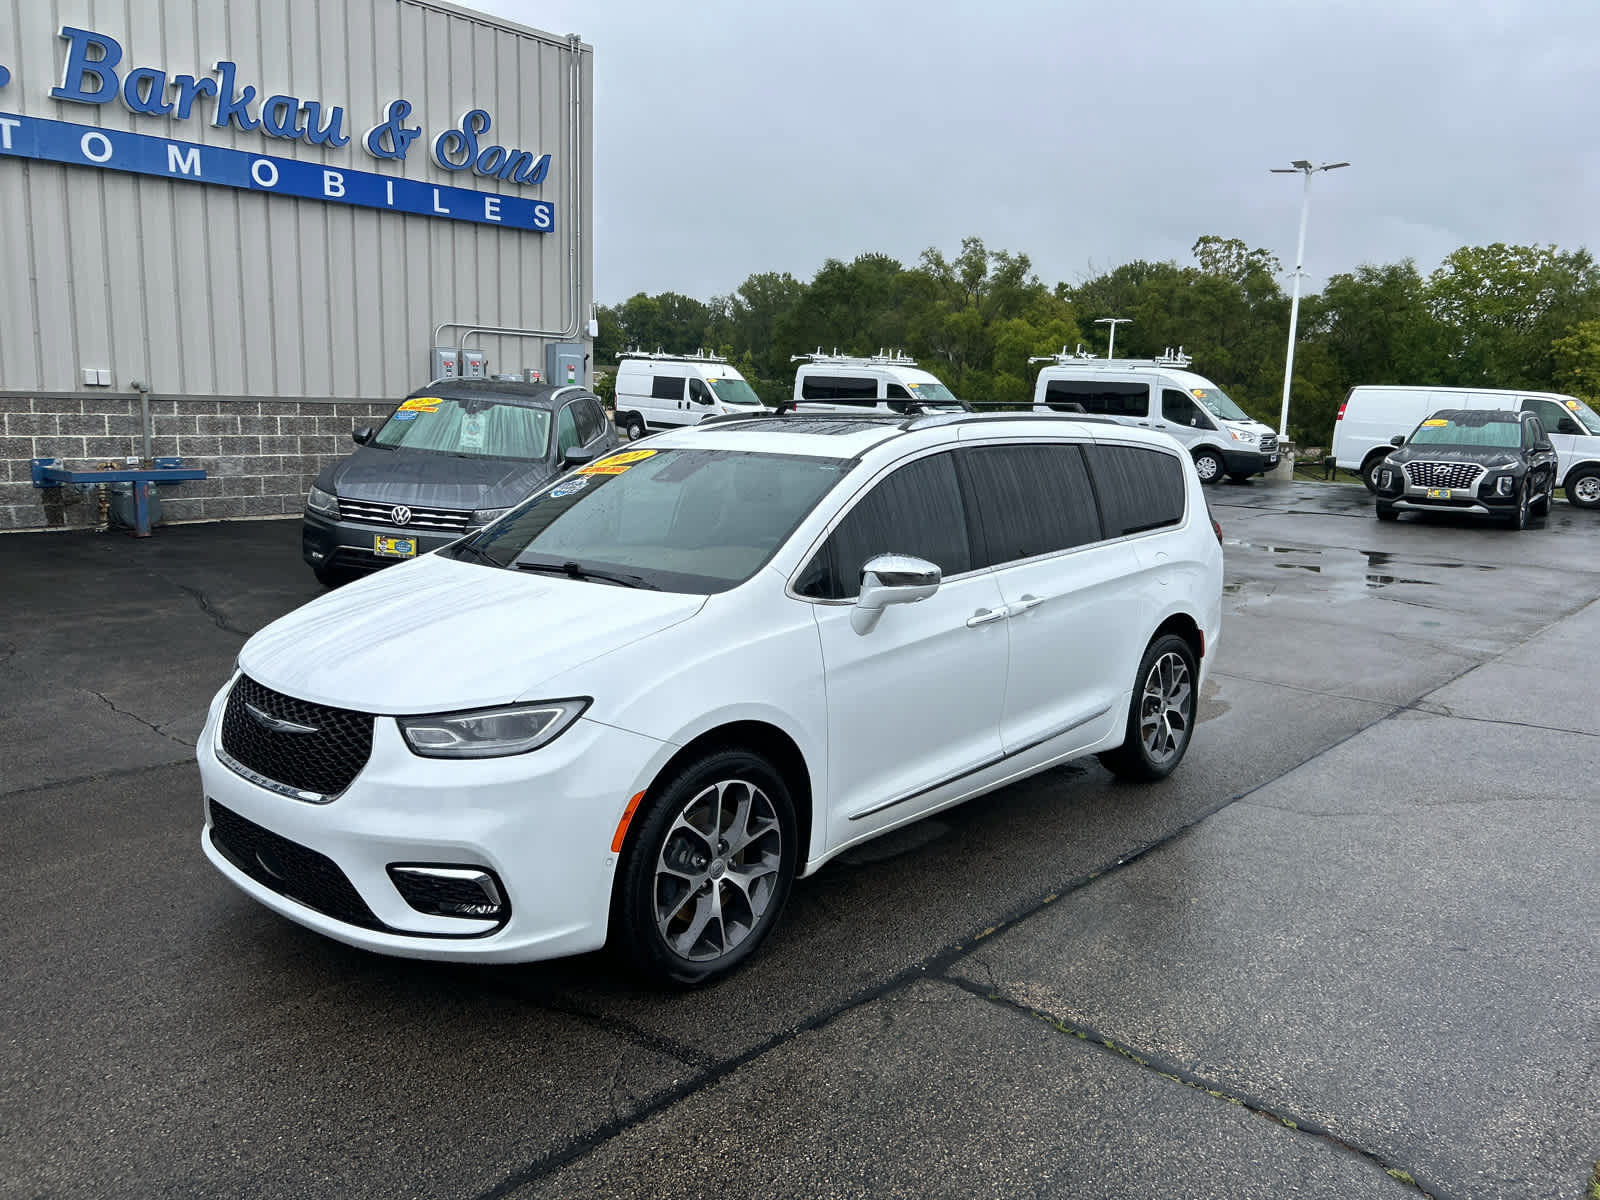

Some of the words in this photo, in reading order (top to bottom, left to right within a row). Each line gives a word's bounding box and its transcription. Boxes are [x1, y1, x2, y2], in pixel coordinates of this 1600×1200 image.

[49, 26, 350, 148] Barkau
[362, 99, 422, 160] &
[431, 109, 552, 185] Sons
